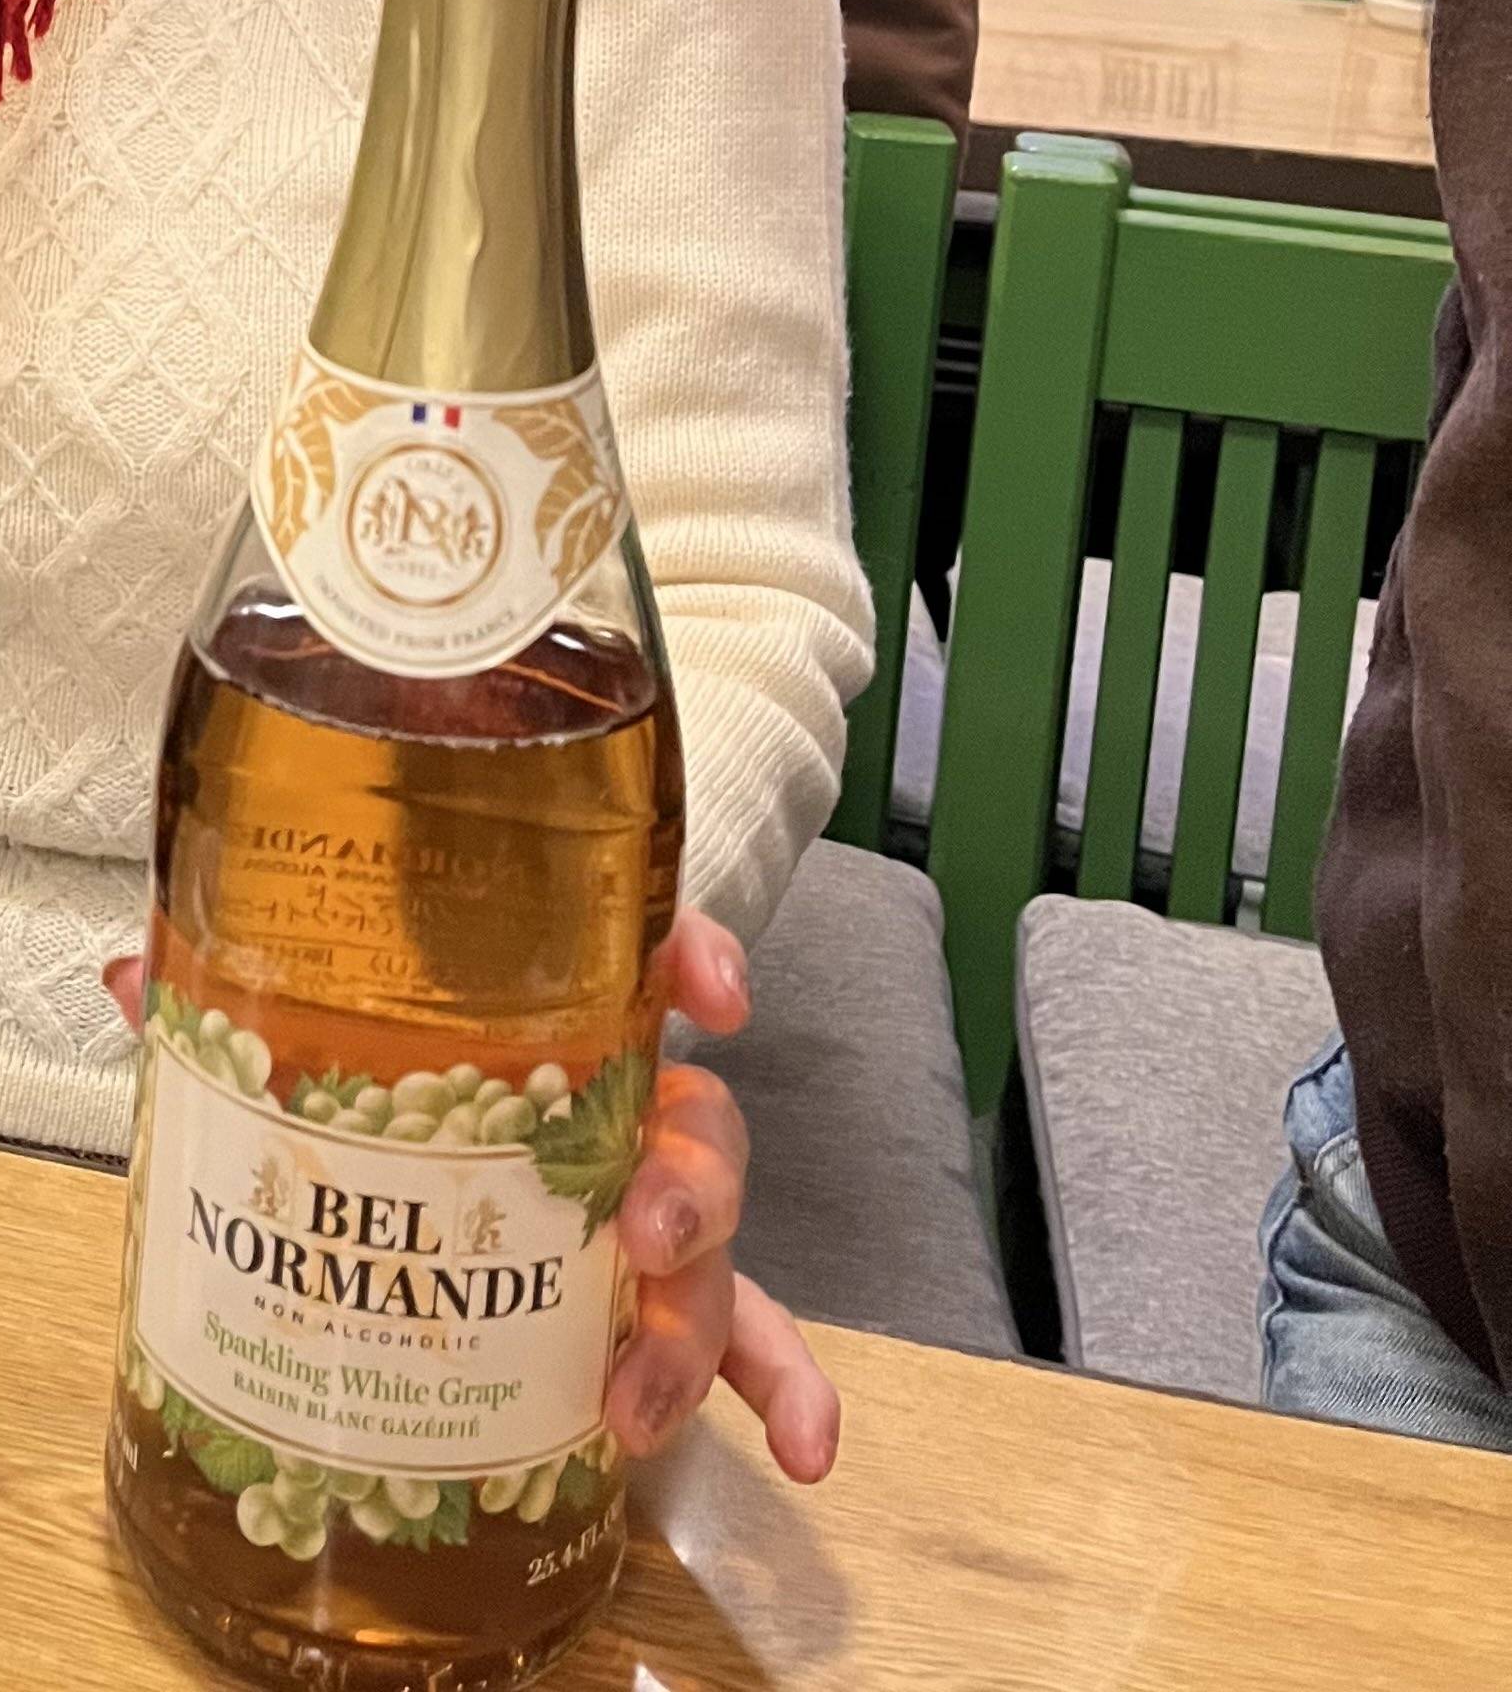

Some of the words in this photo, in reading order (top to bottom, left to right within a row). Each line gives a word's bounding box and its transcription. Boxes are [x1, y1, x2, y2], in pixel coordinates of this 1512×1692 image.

[186, 1186, 565, 1321] NORMANDE
[304, 1181, 441, 1255] BEL
[254, 1295, 306, 1325] NON
[324, 1321, 481, 1351] ALCOHOLIC
[203, 1311, 332, 1396] Sparkling
[340, 1365, 430, 1407] White
[438, 1376, 523, 1410] Grape
[233, 1371, 300, 1414] RAISIN
[305, 1397, 374, 1433] BLANC
[380, 1414, 481, 1439] GAZÉIFIÉ
